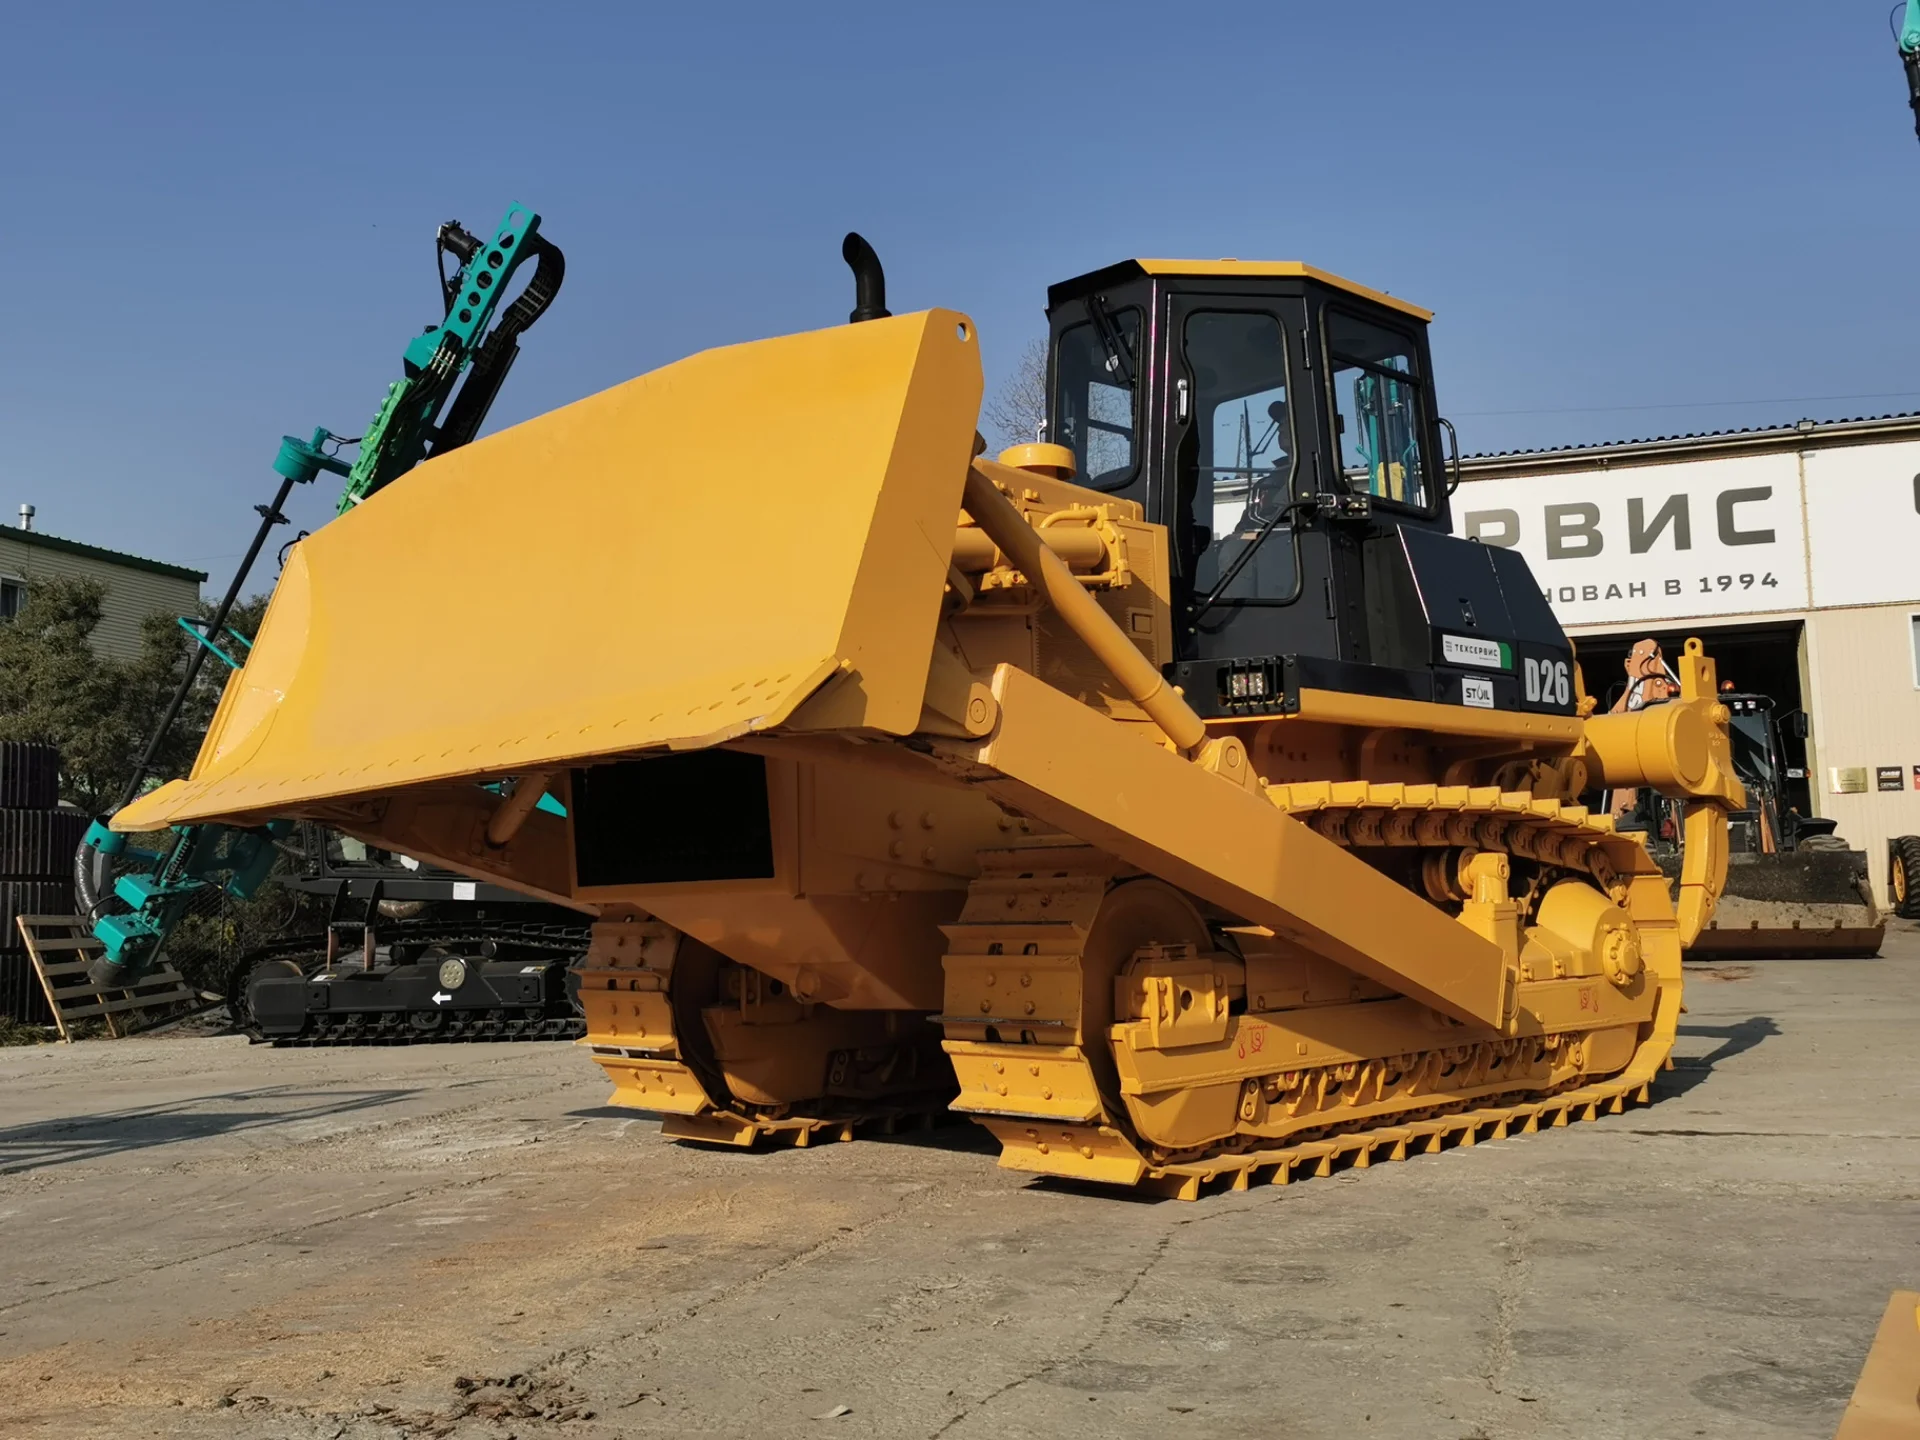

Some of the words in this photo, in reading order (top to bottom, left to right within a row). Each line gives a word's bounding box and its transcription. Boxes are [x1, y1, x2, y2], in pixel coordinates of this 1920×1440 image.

[1665, 579, 1681, 595] В
[1699, 572, 1778, 593] 1994
[1454, 644, 1498, 657] ТЕХСЕРВИС
[1524, 657, 1569, 706] D26
